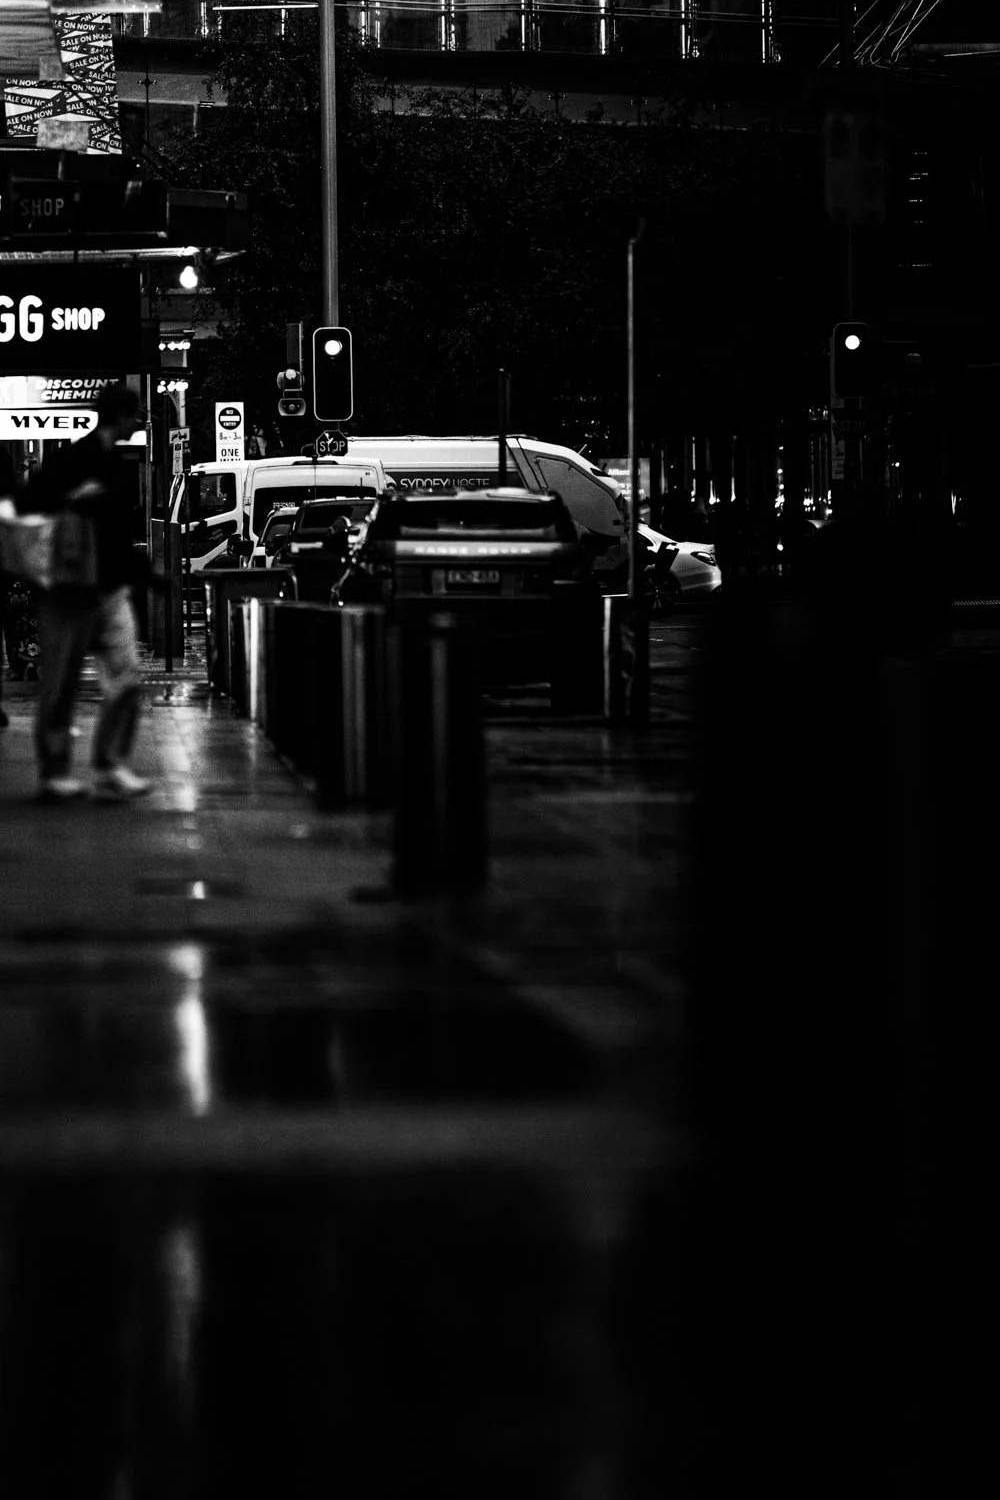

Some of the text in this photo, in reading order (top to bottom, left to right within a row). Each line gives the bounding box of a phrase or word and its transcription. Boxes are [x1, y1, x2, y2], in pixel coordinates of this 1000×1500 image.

[77, 23, 96, 31] NOW
[61, 38, 79, 47] SALE
[80, 34, 92, 43] ON
[70, 59, 87, 69] SALE
[21, 97, 33, 106] ON
[21, 113, 33, 122] ON
[33, 109, 53, 120] NOW
[66, 102, 85, 111] SALE
[19, 198, 65, 217] SHOP
[51, 307, 105, 331] SHOP
[41, 391, 101, 401] CHEMIS
[10, 416, 91, 429] MYER
[220, 448, 240, 457] ONE
